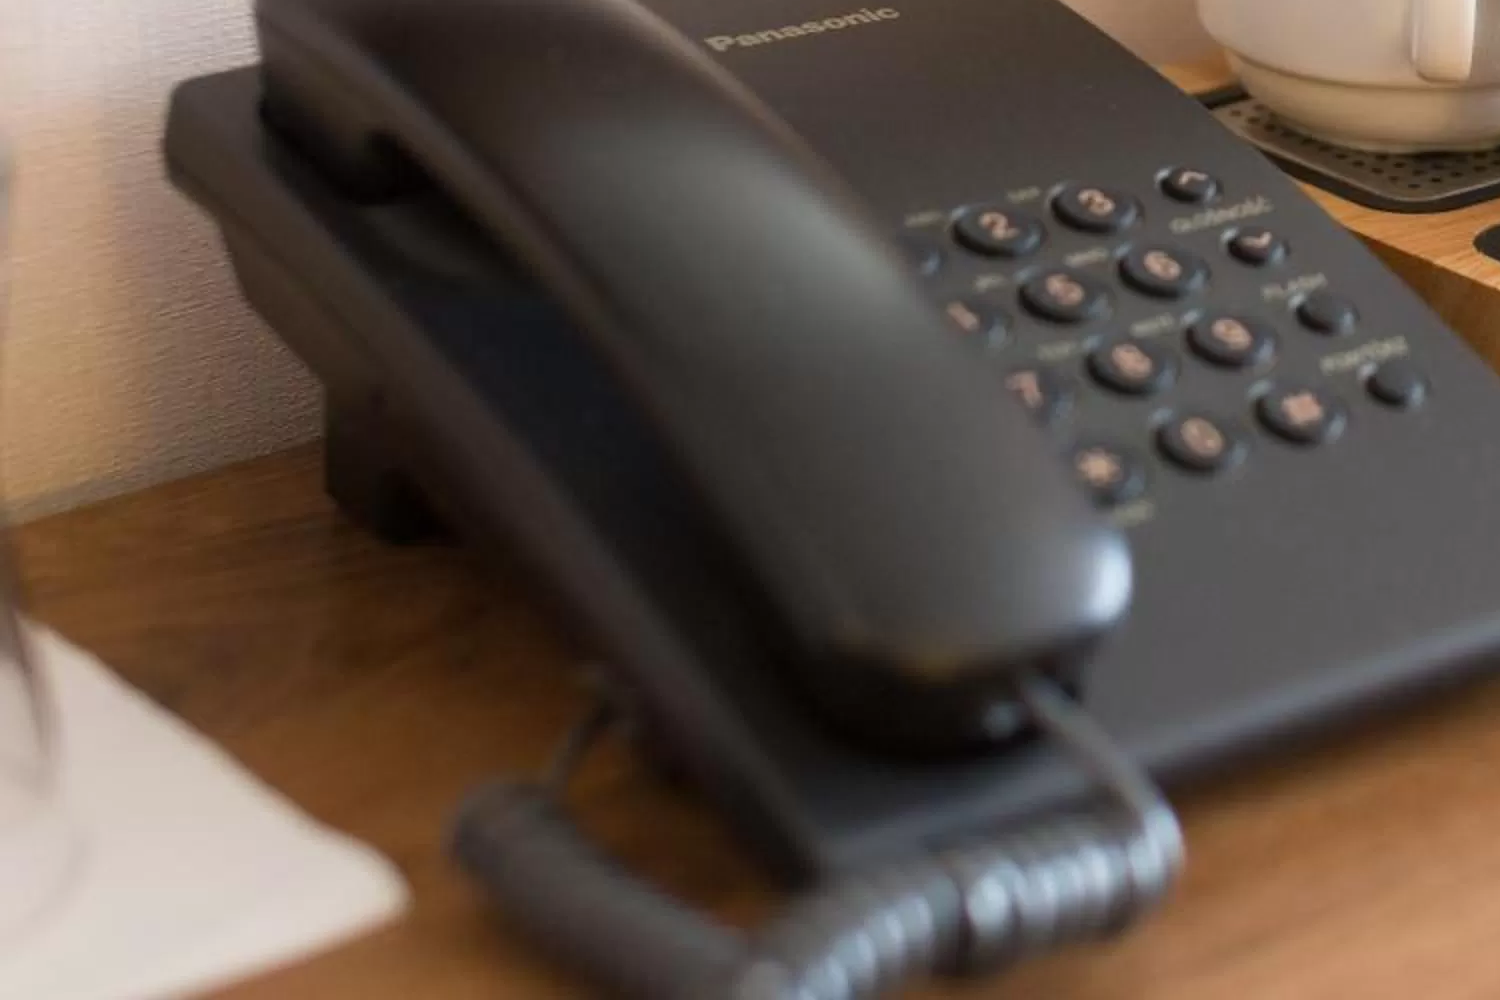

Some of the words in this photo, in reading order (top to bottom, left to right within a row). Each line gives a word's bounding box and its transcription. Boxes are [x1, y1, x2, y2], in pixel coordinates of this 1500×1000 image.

[703, 6, 901, 52] Panasonic
[1077, 188, 1116, 216] 3
[978, 211, 1020, 241] 2
